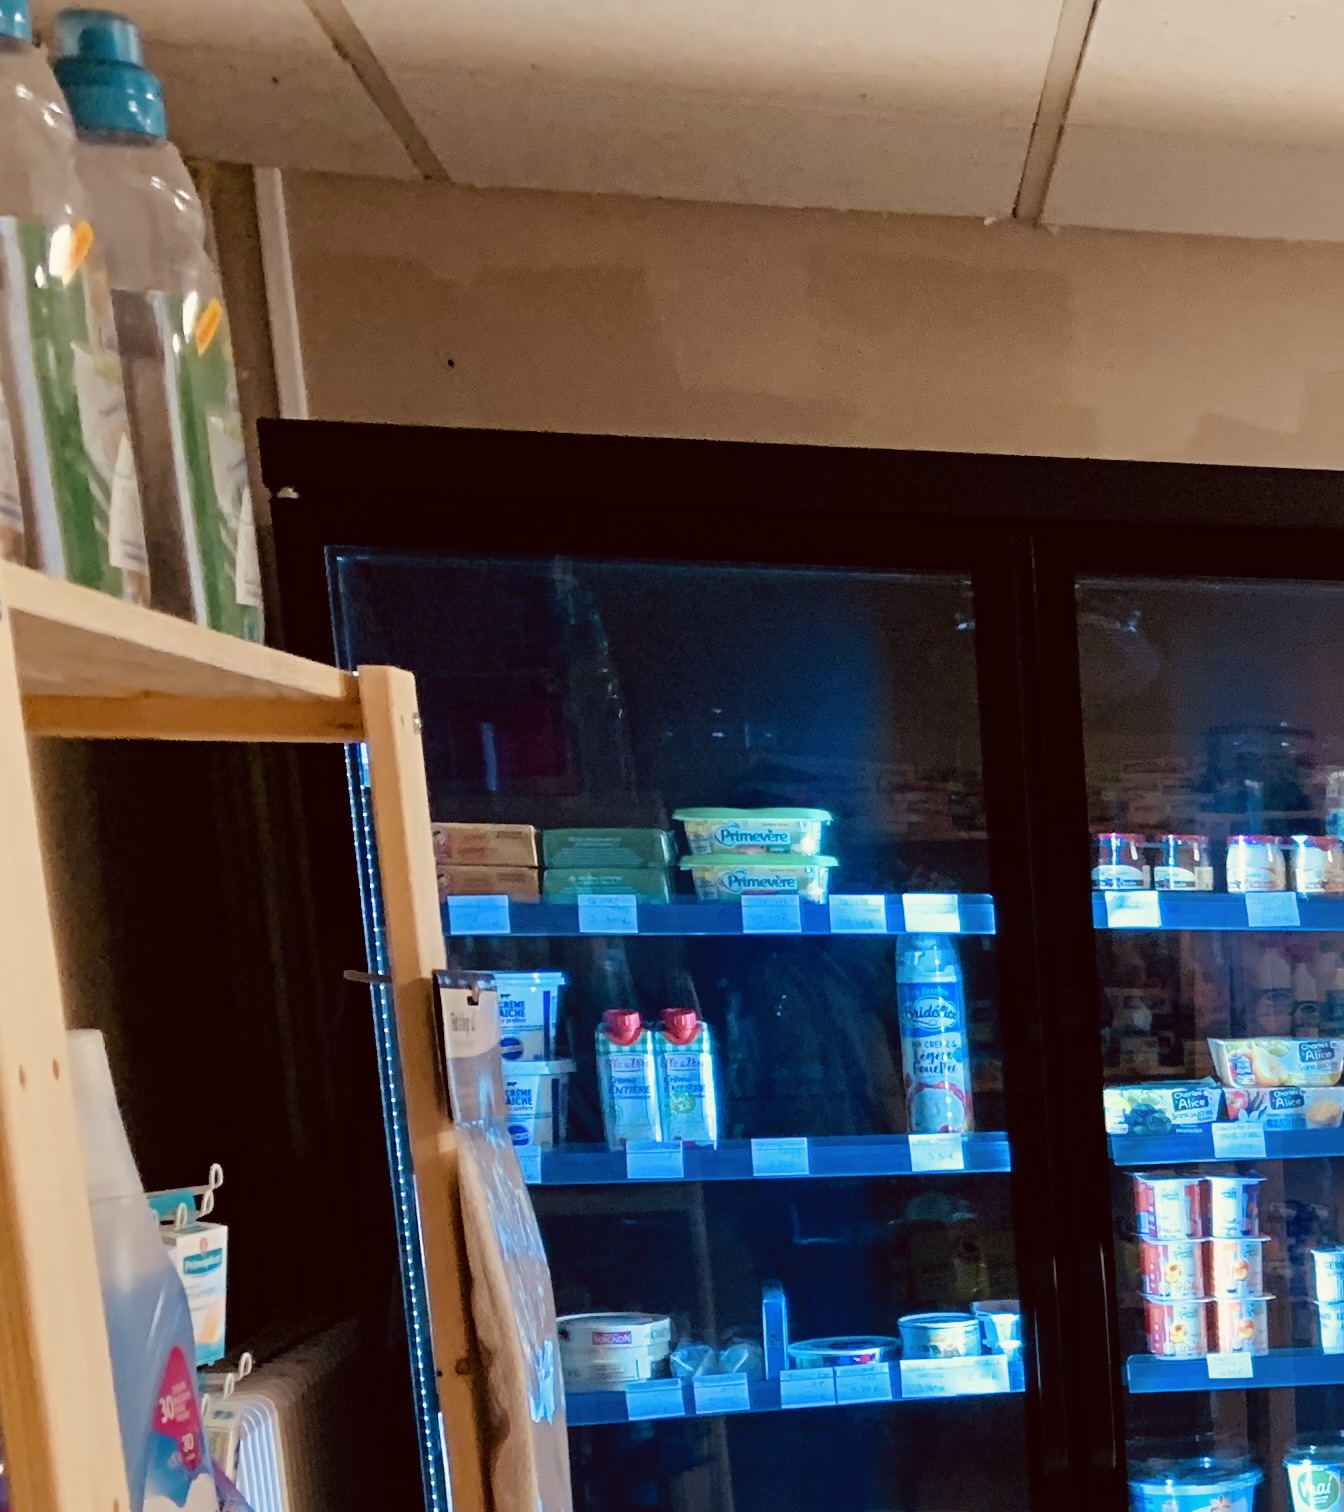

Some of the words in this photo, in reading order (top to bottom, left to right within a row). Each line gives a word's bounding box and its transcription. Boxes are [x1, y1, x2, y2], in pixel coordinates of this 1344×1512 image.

[720, 828, 788, 843] Primevère
[727, 875, 796, 890] Primevère
[1304, 1050, 1335, 1061] Alice
[1177, 1098, 1208, 1110] Alice
[1274, 1097, 1305, 1109] Alice
